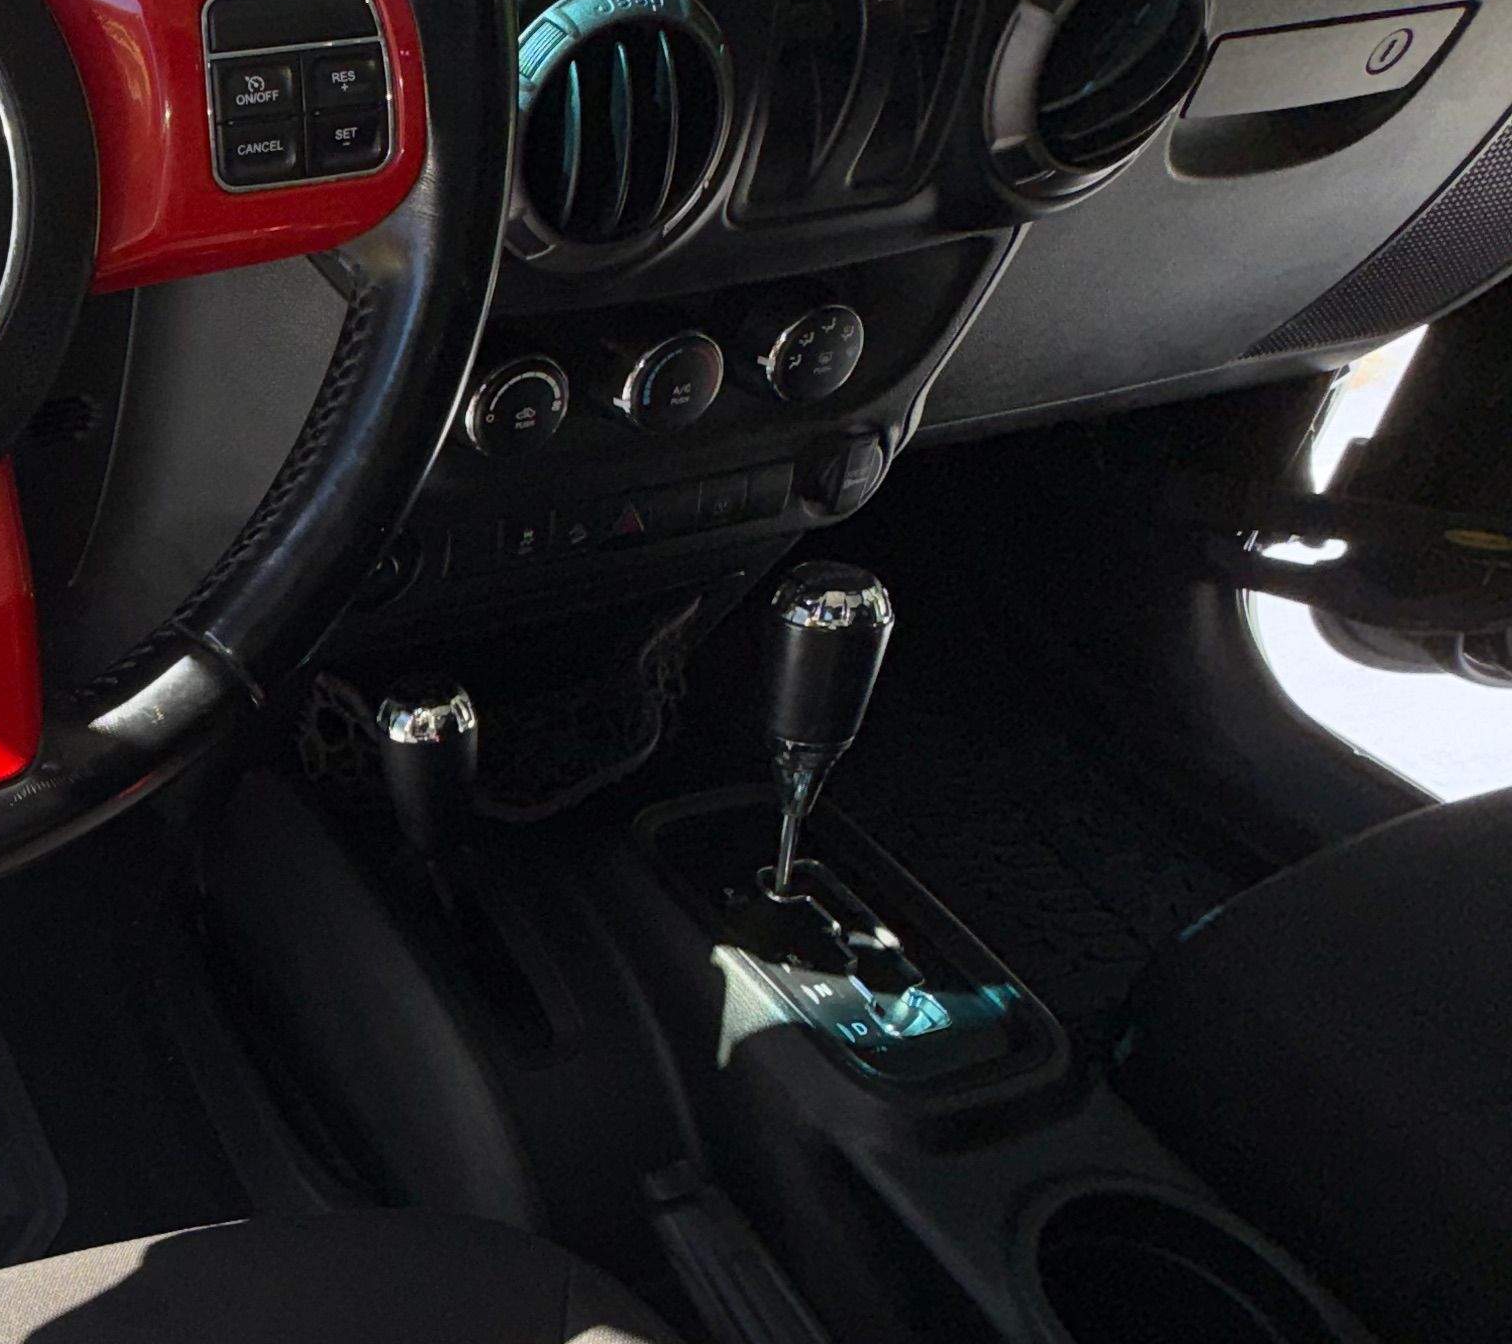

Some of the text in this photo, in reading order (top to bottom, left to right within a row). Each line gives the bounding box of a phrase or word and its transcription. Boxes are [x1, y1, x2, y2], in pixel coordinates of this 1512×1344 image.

[331, 70, 356, 84] RES
[235, 88, 280, 106] ON/OFF
[334, 126, 358, 141] SET
[236, 140, 285, 156] CANCEL
[672, 382, 692, 396] A/C
[812, 982, 832, 999] N
[850, 1021, 868, 1037] D
